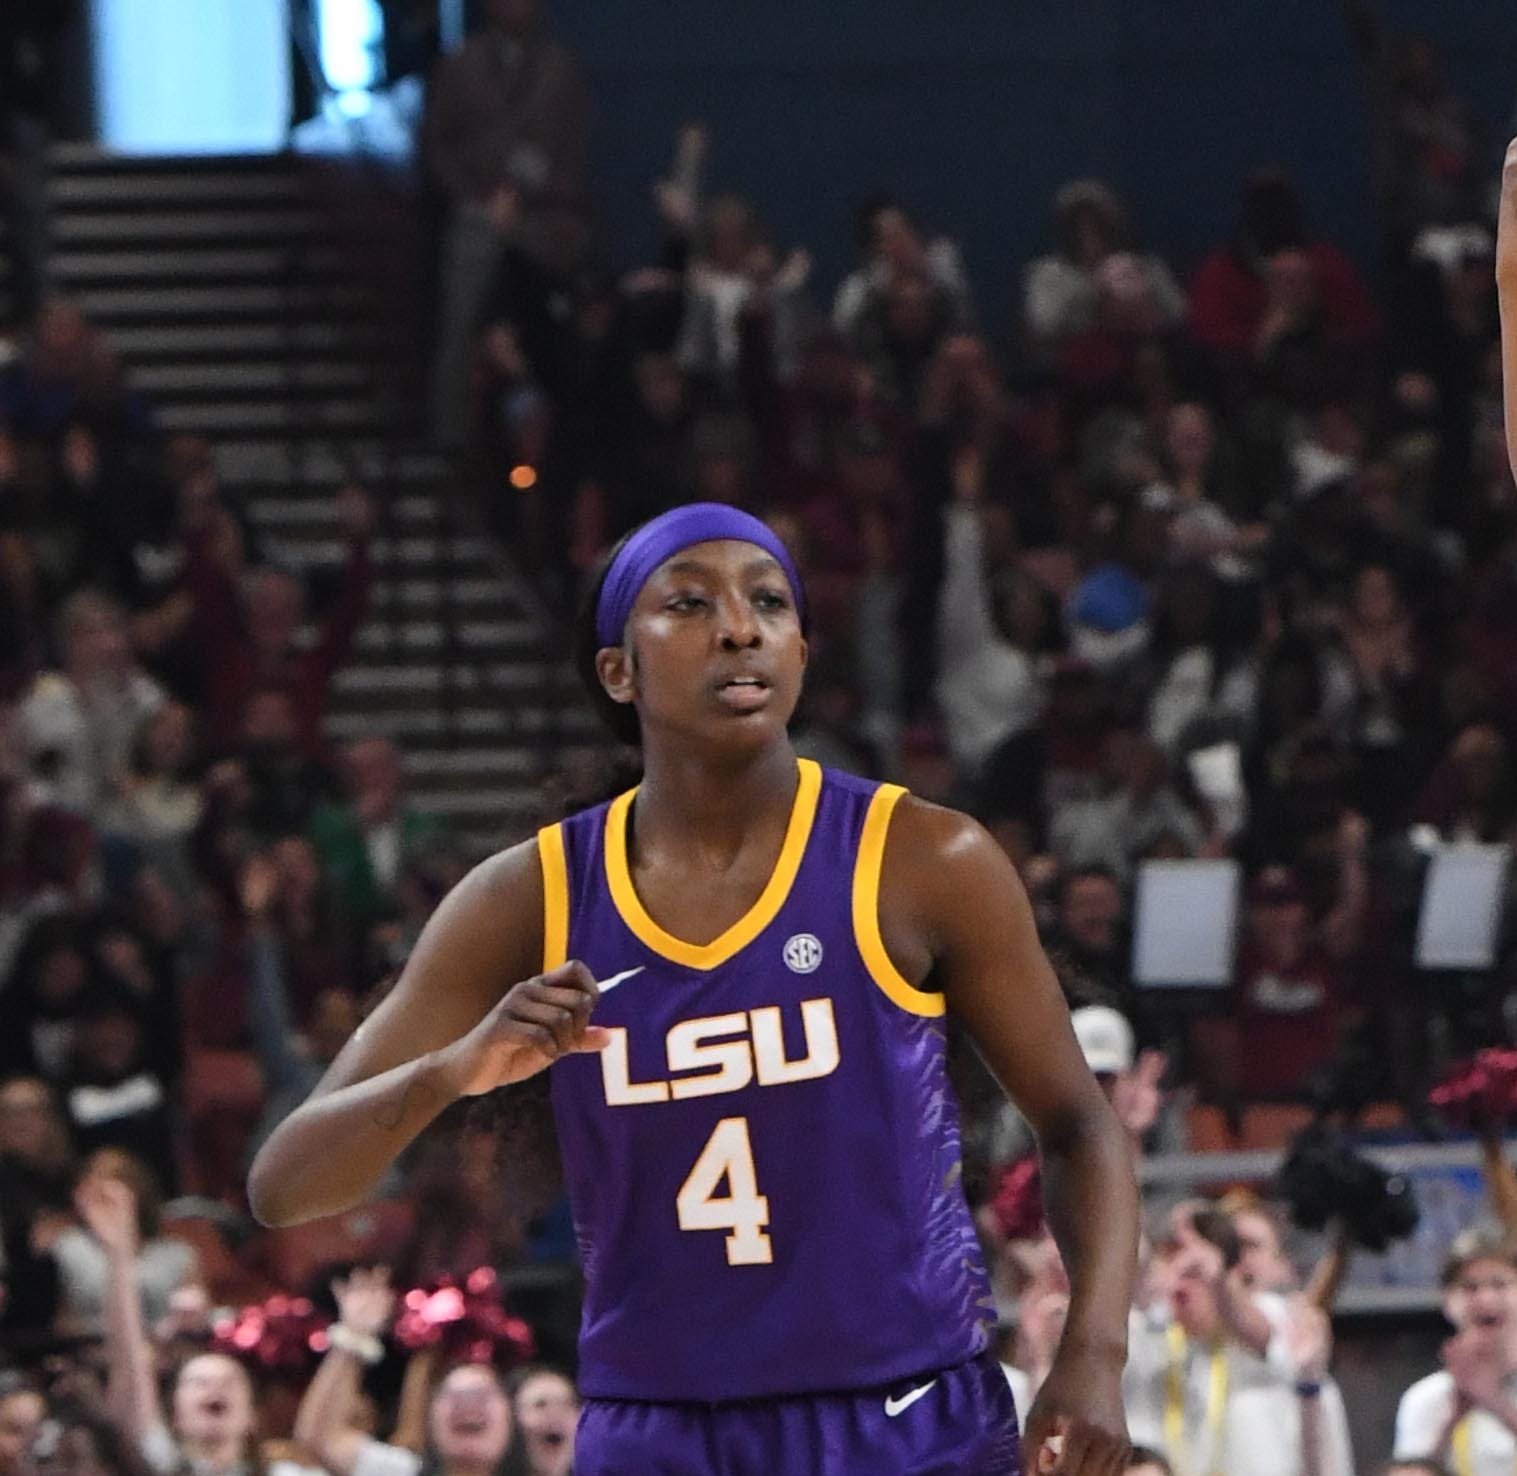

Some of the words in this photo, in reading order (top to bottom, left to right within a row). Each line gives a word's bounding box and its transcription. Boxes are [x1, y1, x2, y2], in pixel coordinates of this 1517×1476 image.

[785, 936, 820, 971] SEC
[600, 997, 840, 1106] LSU
[676, 1117, 773, 1266] 4
